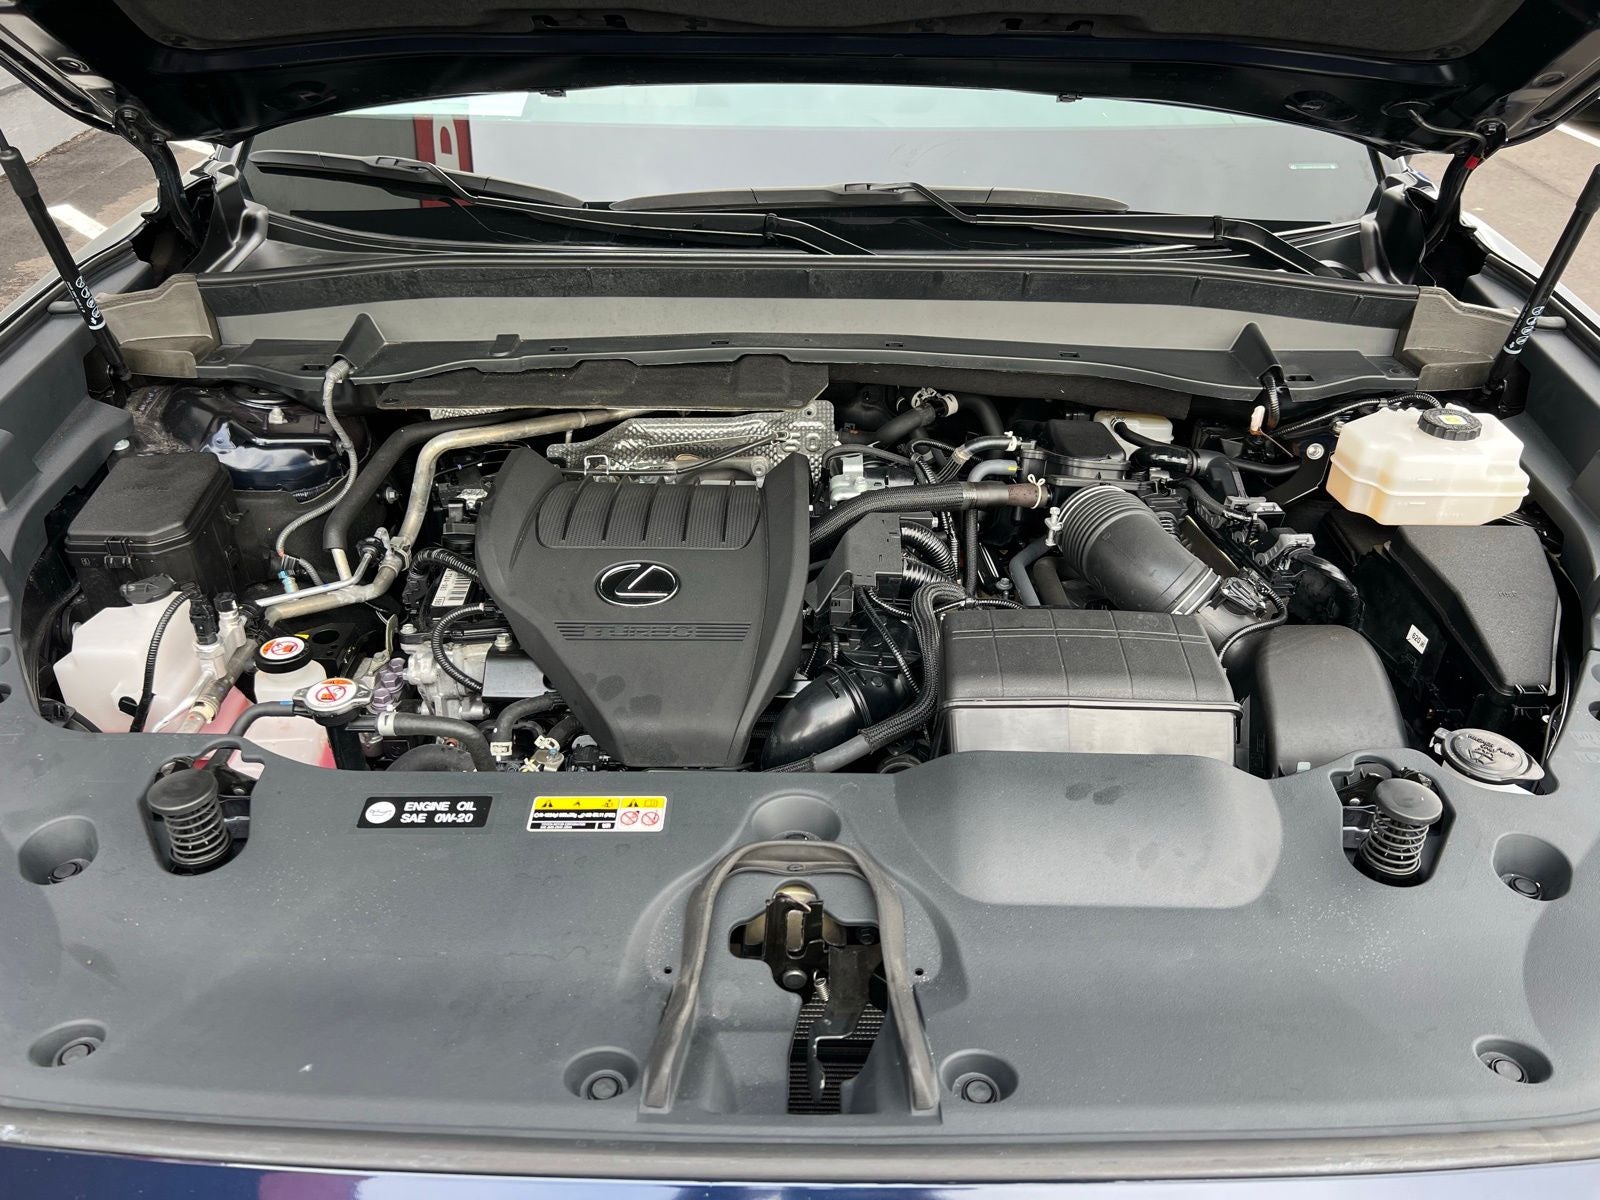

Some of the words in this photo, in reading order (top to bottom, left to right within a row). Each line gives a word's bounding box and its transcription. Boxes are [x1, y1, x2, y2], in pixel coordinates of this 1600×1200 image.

[591, 625, 694, 637] TURBO
[403, 801, 450, 811] ENGINE
[456, 801, 477, 811] OIL
[400, 813, 427, 823] SAE
[434, 813, 474, 823] 0W-20
